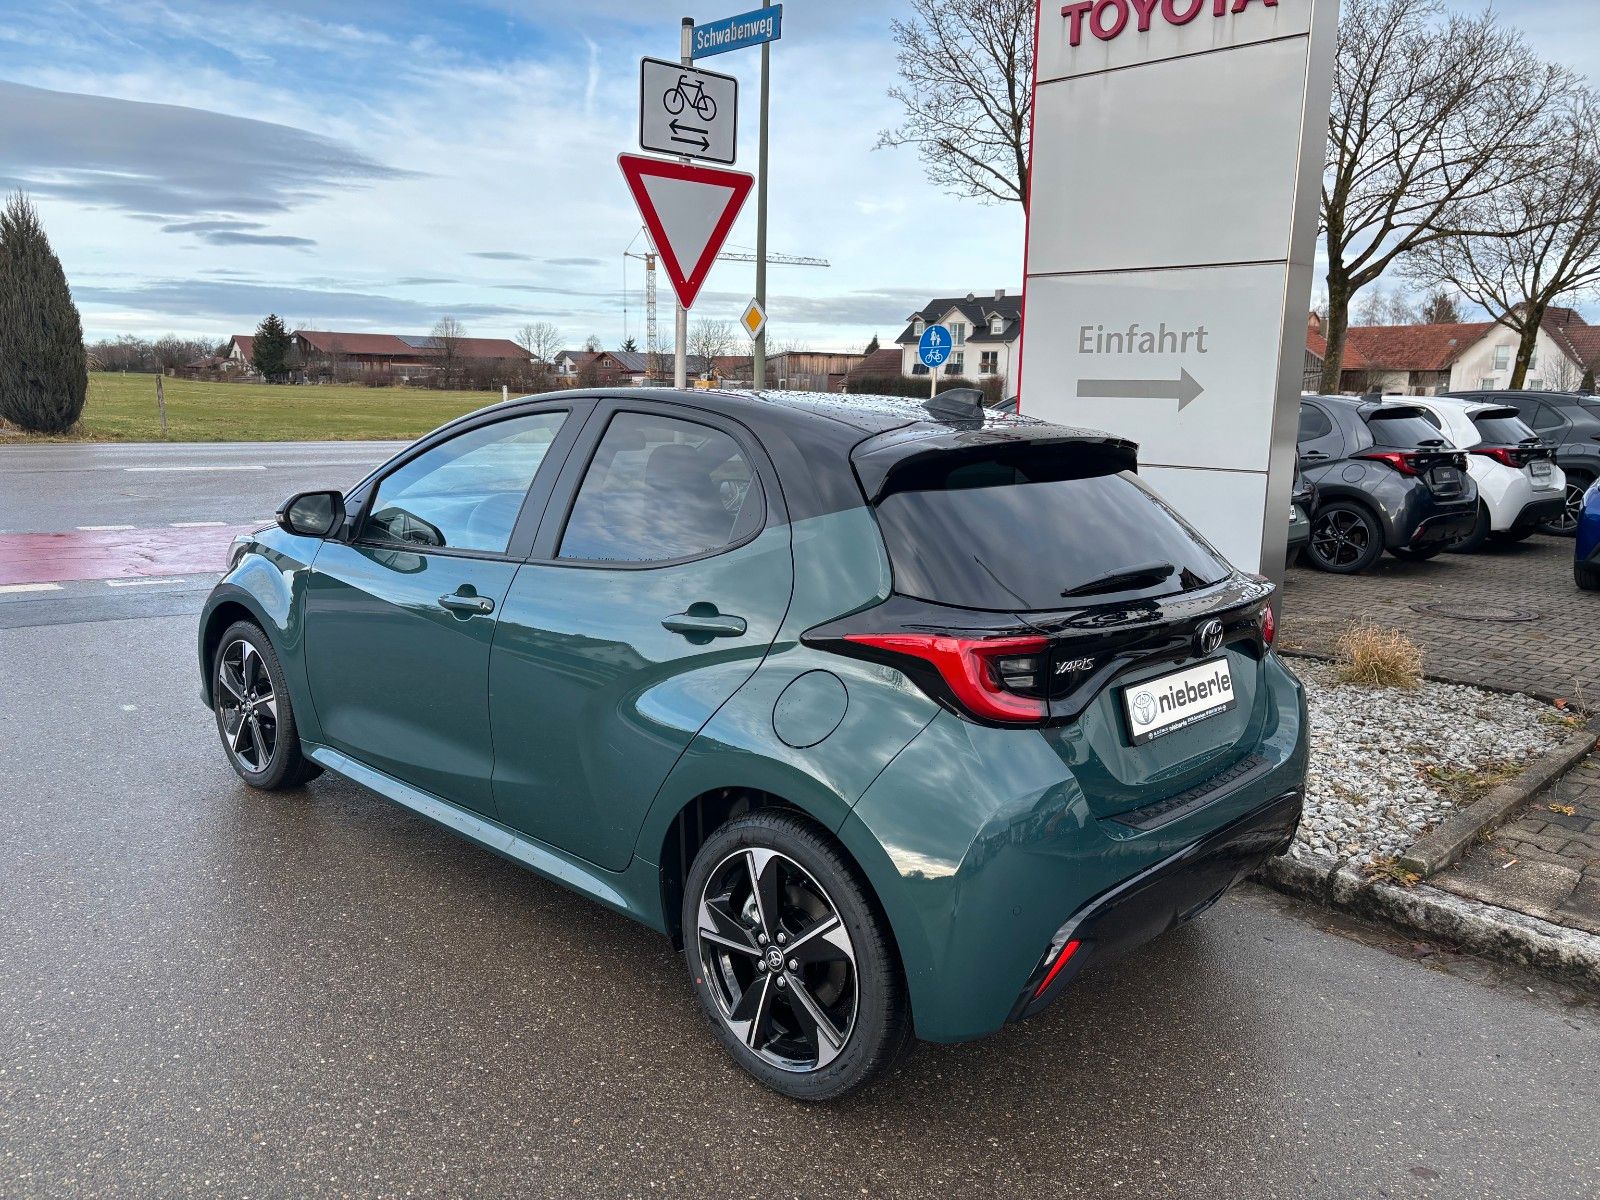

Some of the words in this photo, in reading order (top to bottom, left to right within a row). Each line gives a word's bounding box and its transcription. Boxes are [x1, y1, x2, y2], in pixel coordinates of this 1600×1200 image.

[697, 17, 773, 49] Schwabenweg
[1061, 0, 1278, 47] TOYO
[1078, 322, 1209, 354] Einfahrt
[1158, 671, 1231, 713] nieberle
